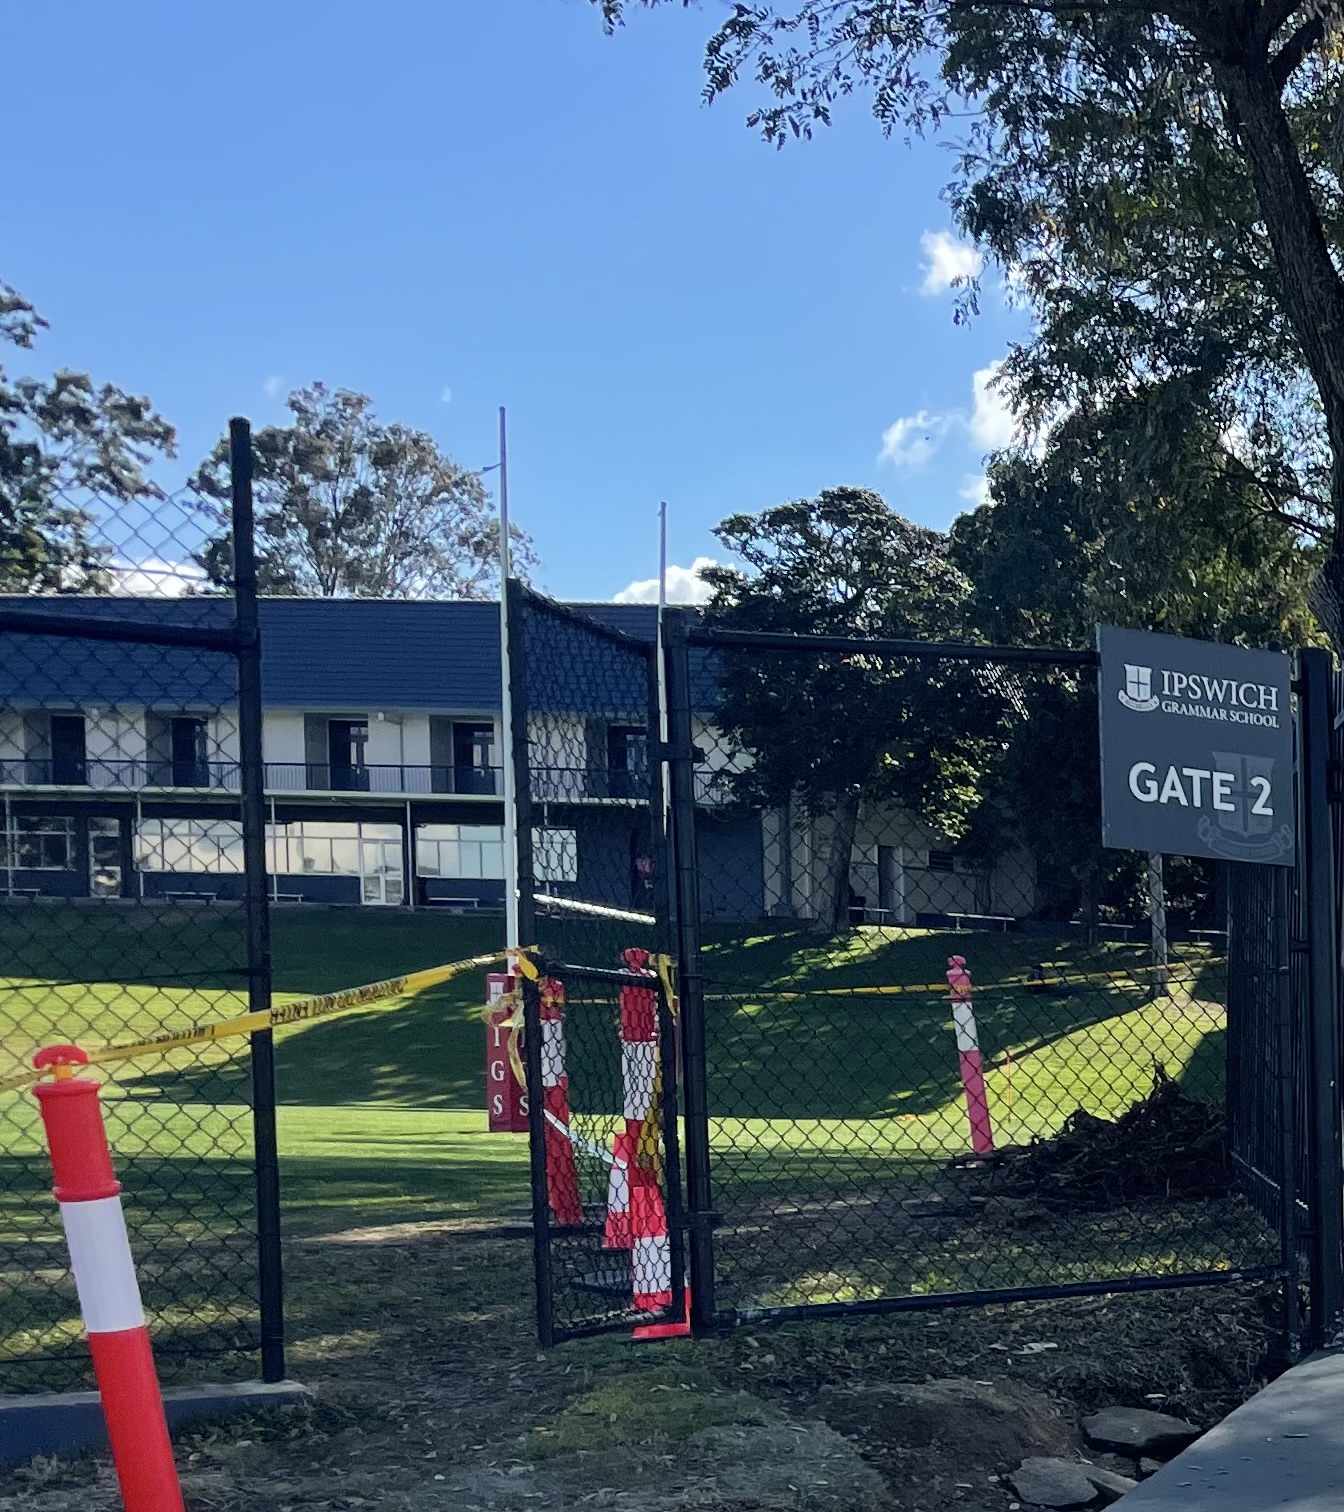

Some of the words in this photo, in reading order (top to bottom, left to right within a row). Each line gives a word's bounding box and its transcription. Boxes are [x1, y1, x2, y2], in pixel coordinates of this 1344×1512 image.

[1160, 669, 1279, 712] IPSWICH
[1161, 700, 1229, 721] GRAMMAR
[1229, 710, 1280, 729] SCHOOL
[1128, 761, 1236, 812] GATE
[1250, 776, 1274, 816] 2
